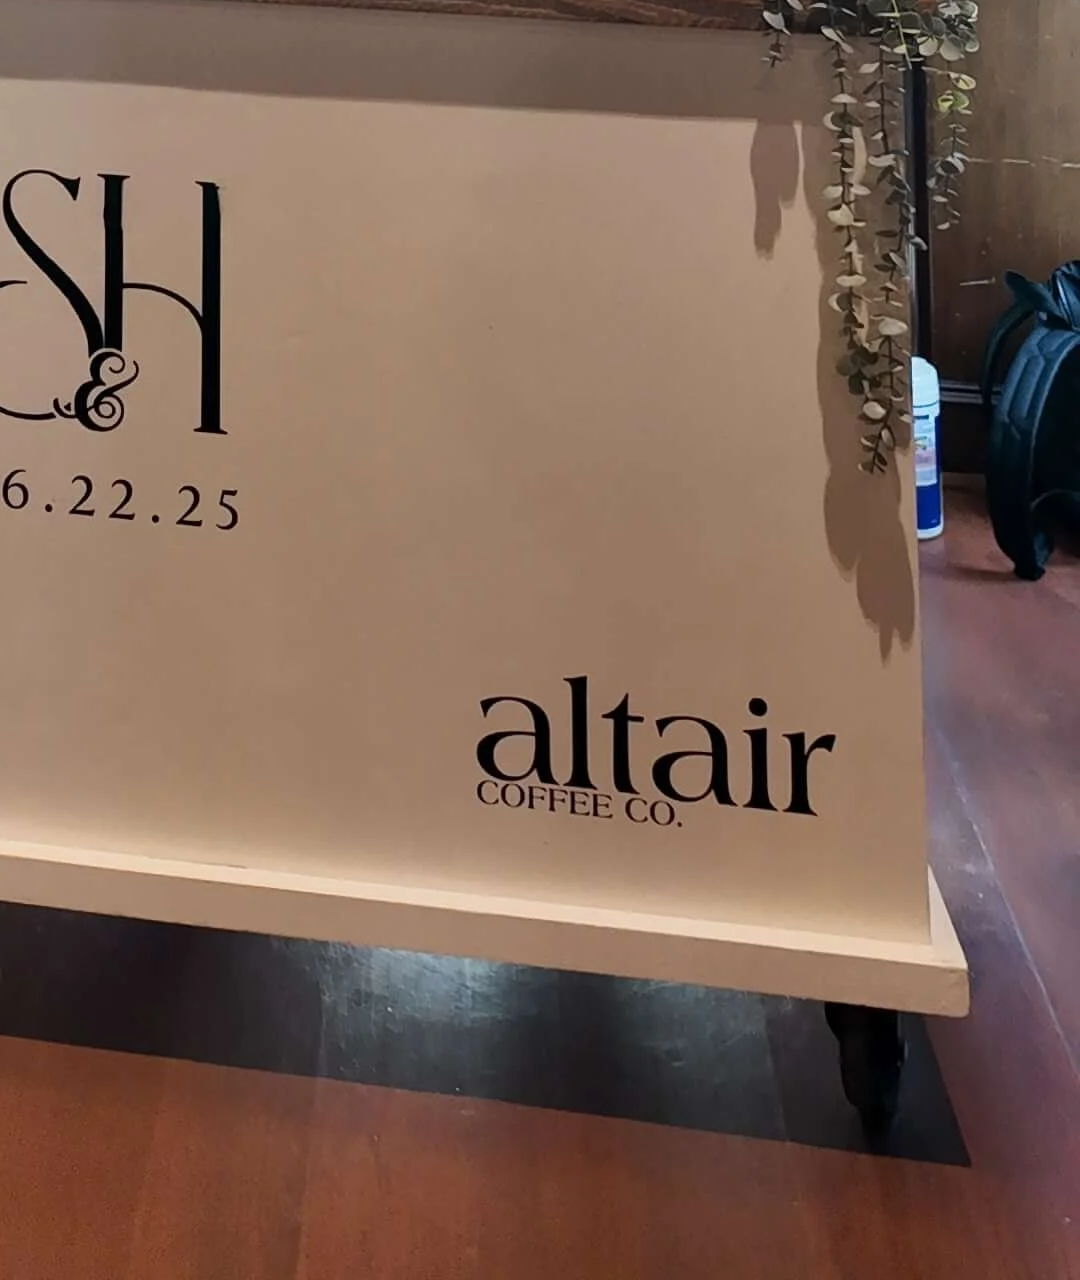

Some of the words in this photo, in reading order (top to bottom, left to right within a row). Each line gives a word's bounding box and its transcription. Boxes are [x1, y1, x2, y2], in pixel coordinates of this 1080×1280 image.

[1, 468, 240, 532] 6.22.25
[475, 674, 837, 818] altair
[476, 779, 615, 820] COFFEE
[624, 796, 684, 828] CO.
